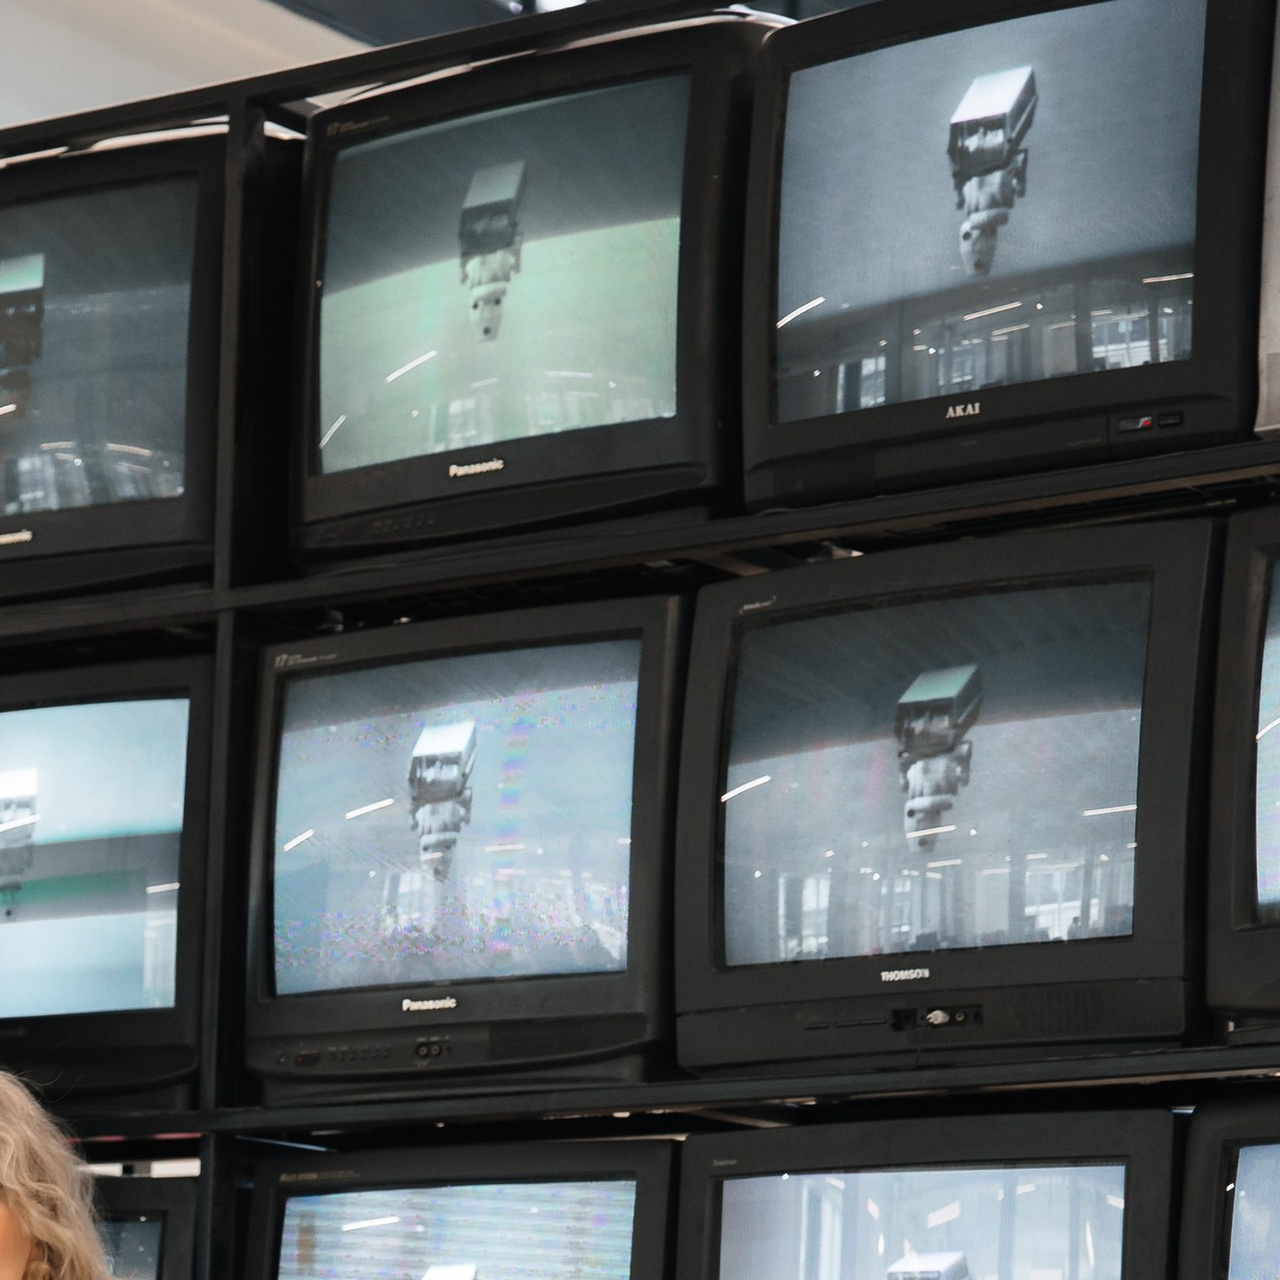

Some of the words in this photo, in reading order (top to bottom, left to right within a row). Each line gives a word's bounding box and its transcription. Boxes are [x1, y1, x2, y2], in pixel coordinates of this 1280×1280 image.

[946, 402, 981, 419] AKAI
[448, 457, 504, 477] Panasonic
[880, 967, 930, 982] THOMSON
[402, 996, 457, 1012] Panasonic
